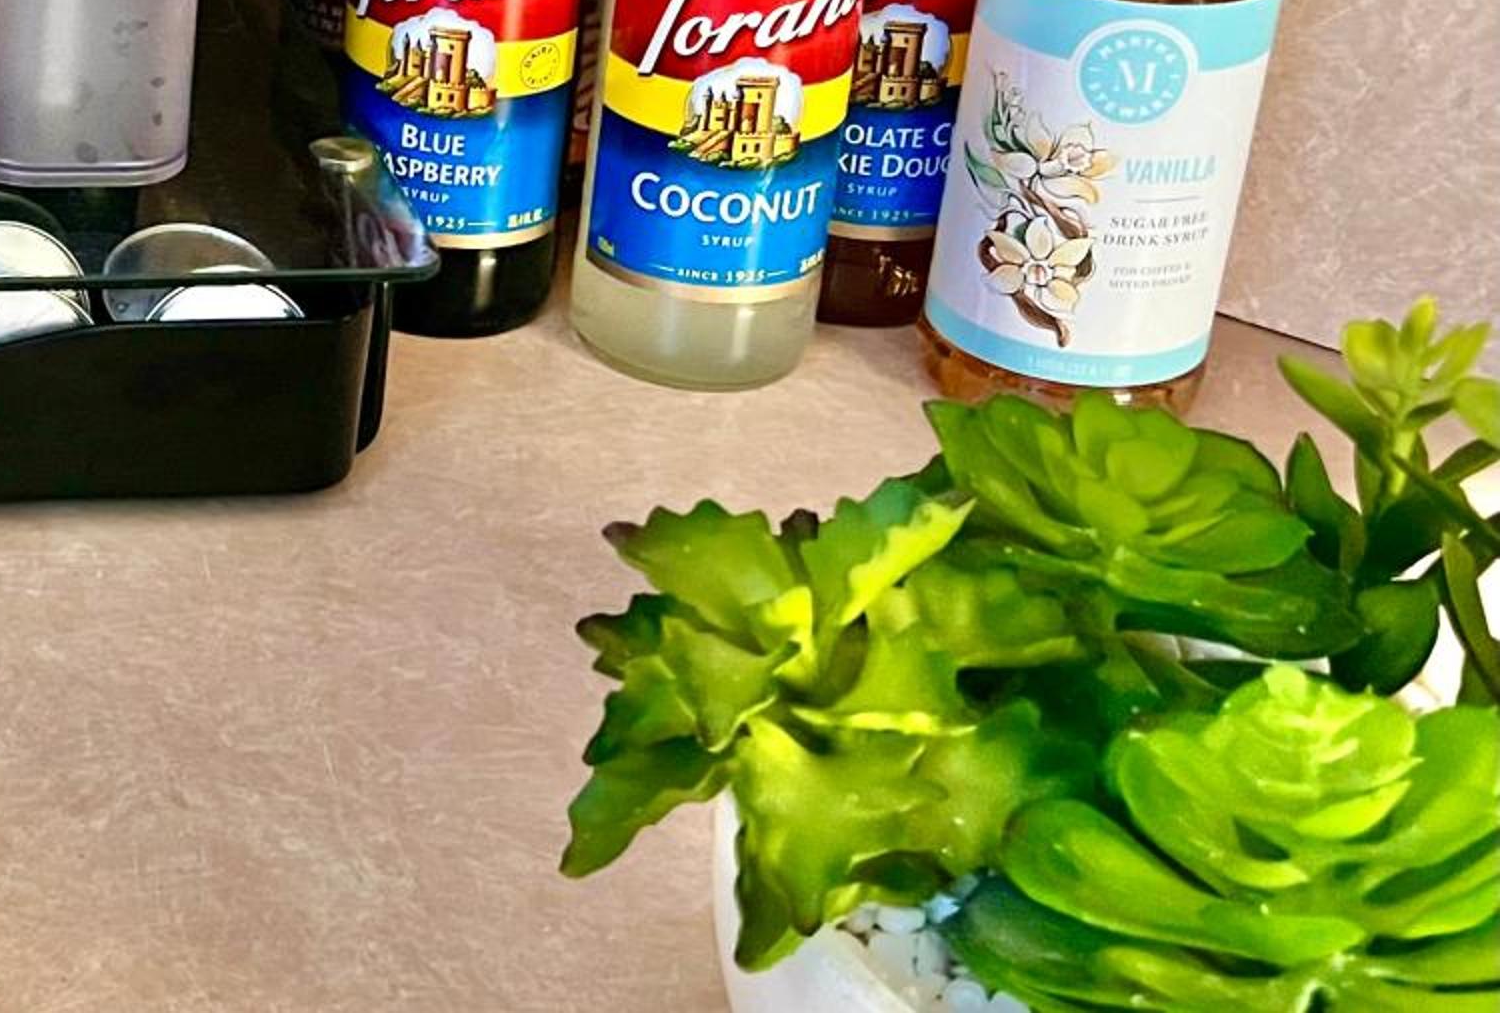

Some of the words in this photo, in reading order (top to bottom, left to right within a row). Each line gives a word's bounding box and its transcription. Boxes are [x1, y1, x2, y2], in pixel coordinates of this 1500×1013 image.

[401, 122, 466, 157] BLUE
[845, 123, 925, 148] OLATE
[382, 151, 502, 187] ASPBERRY
[838, 152, 873, 177] KIE
[1125, 155, 1217, 185] VANILLA
[631, 171, 823, 225] COCONUT
[846, 182, 899, 197] SYRUP
[426, 214, 466, 230] 1925
[1109, 216, 1168, 230] SUGAR
[702, 234, 756, 249] SYRUP
[1102, 233, 1159, 247] DRINK
